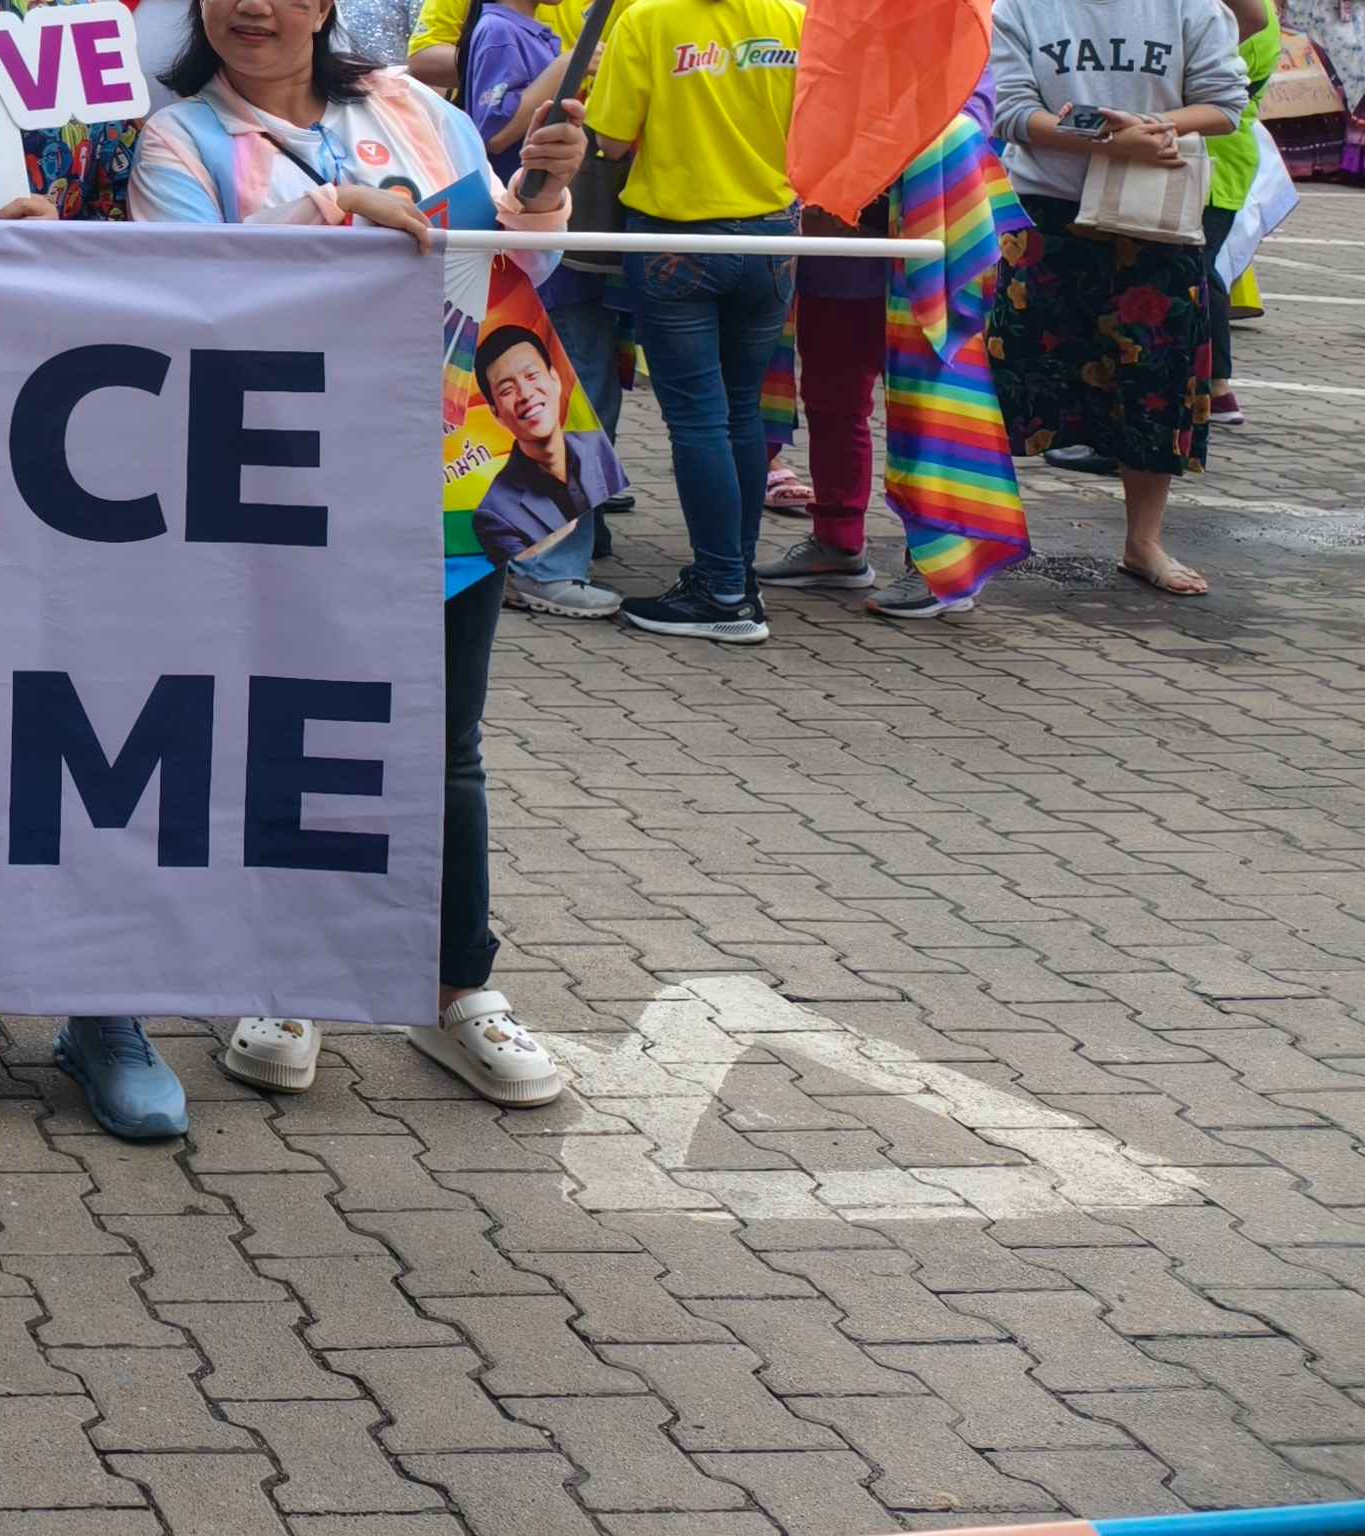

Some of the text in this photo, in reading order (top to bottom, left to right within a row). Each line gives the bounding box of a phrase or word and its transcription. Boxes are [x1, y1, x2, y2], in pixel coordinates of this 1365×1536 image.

[672, 37, 799, 76] Indy Team
[1039, 38, 1173, 77] YALE
